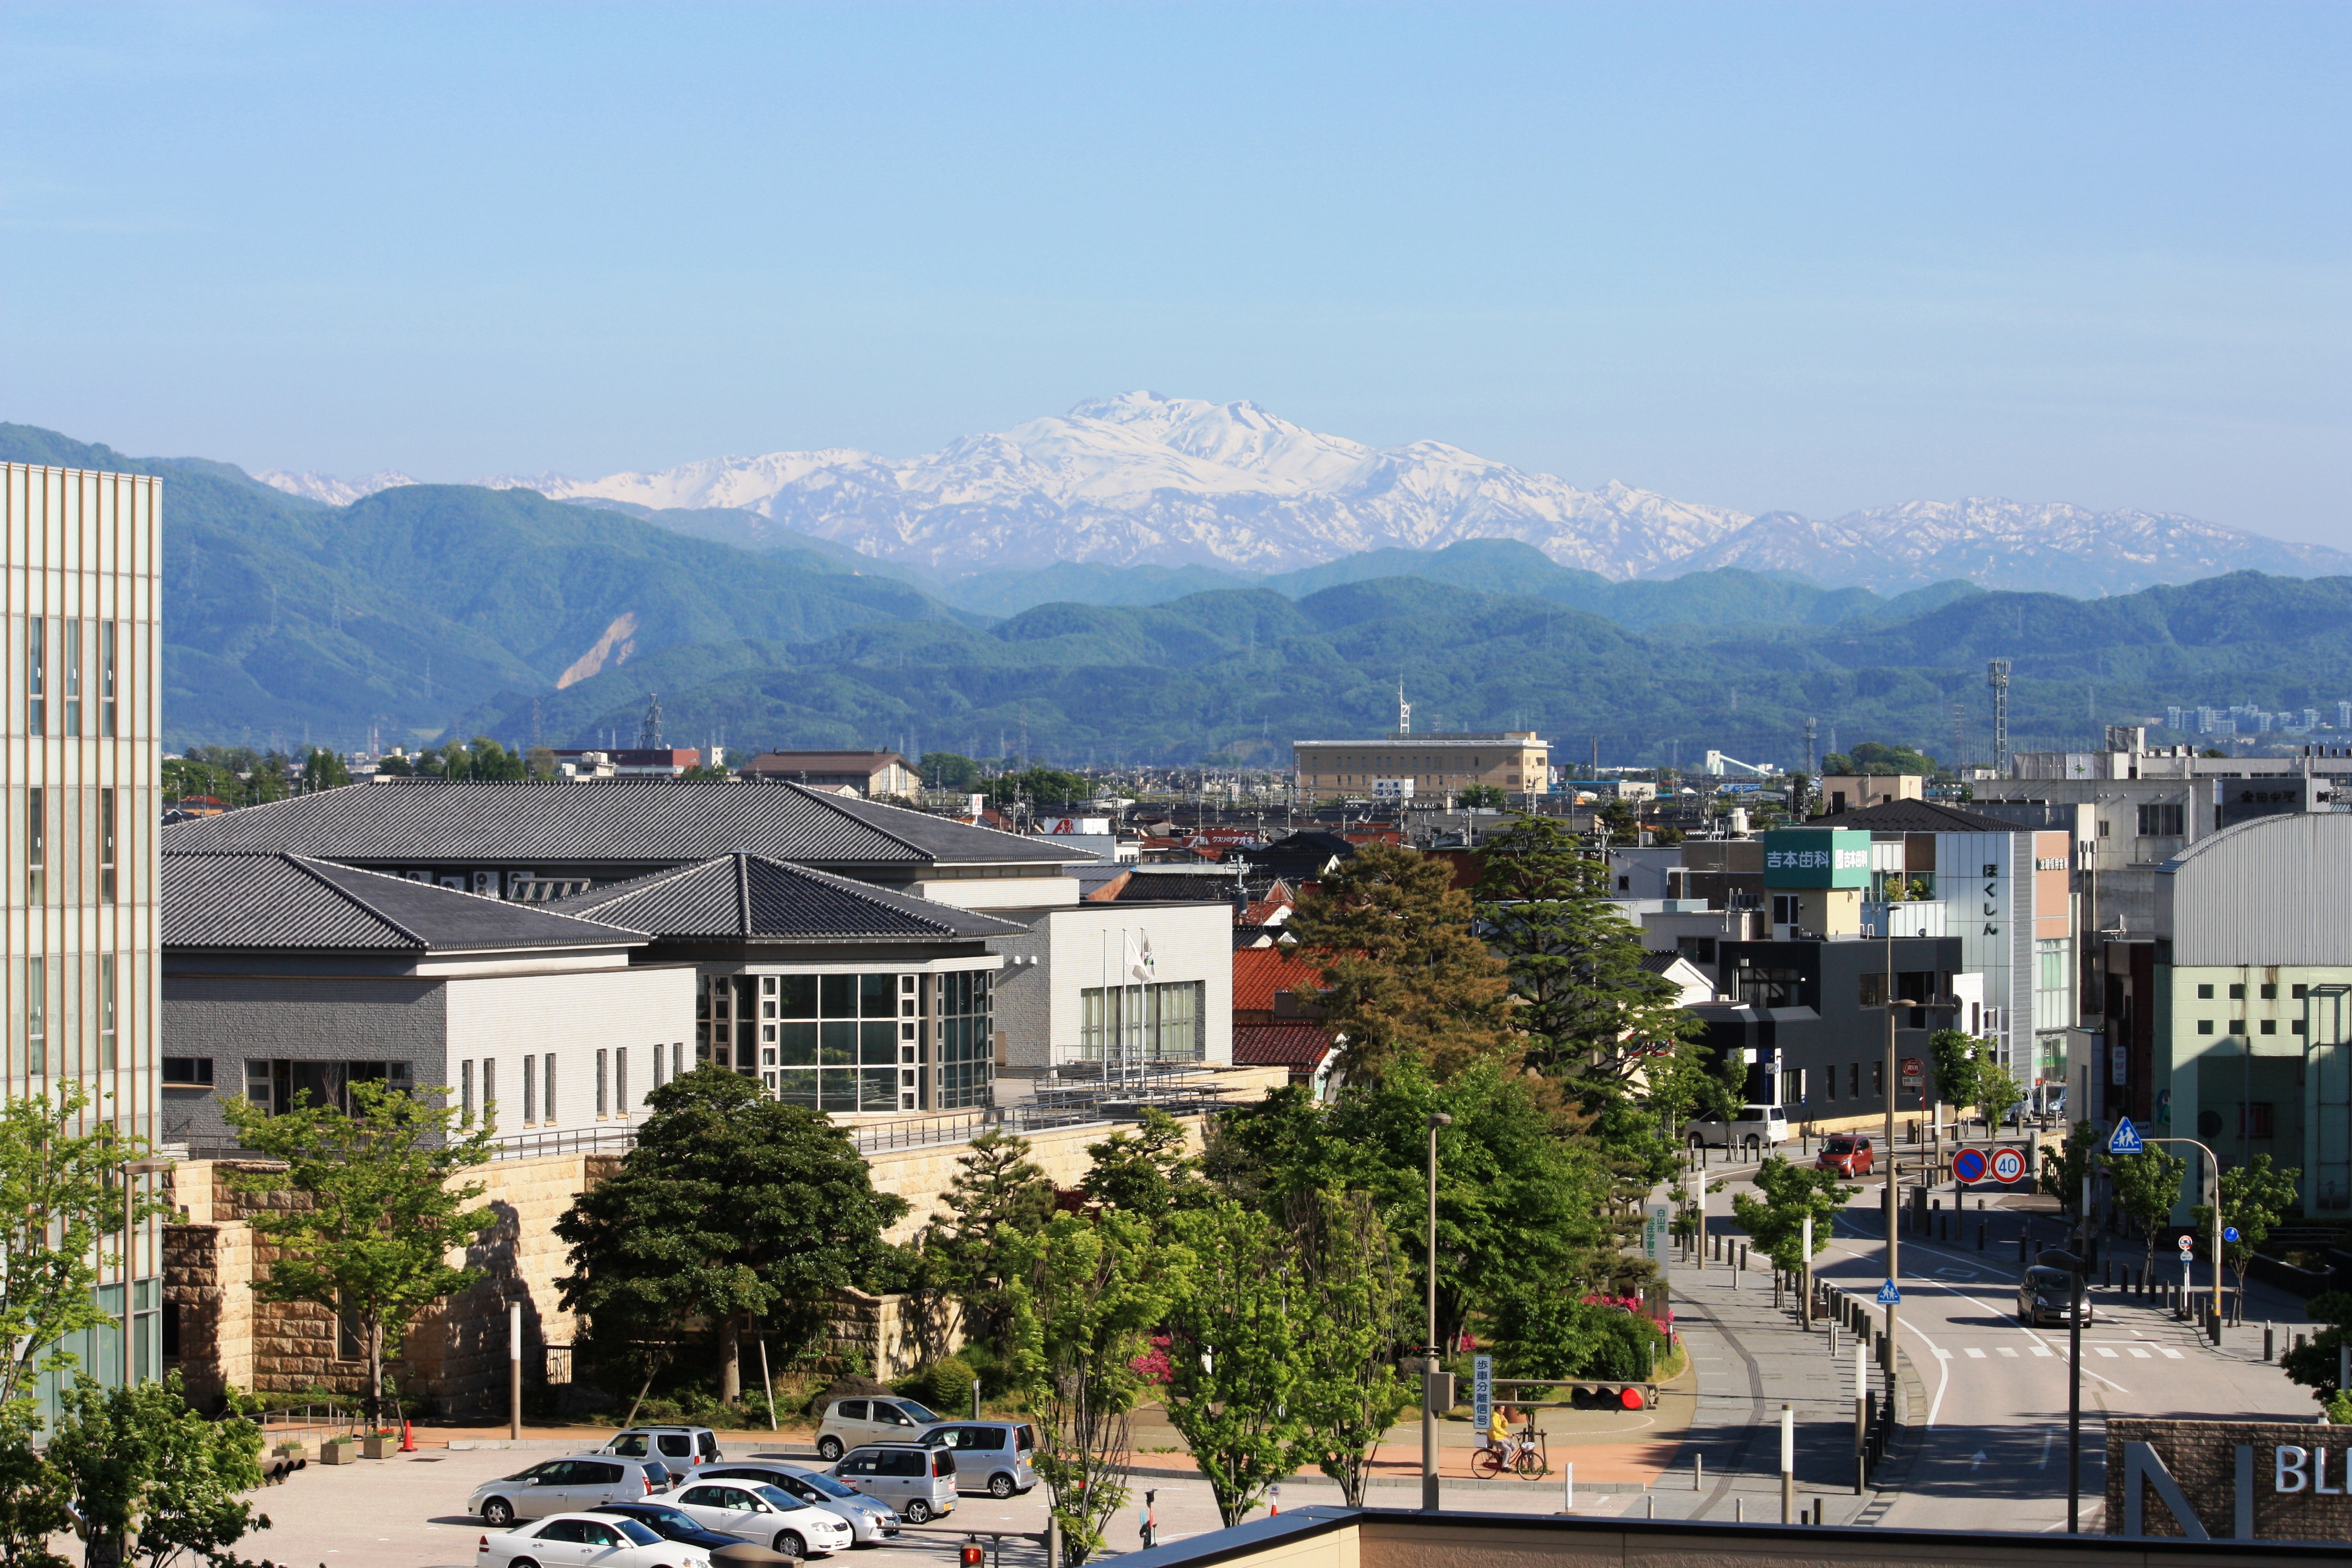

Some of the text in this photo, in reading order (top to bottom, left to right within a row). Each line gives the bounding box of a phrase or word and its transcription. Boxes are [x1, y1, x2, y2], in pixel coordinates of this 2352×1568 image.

[1212, 836, 1255, 844] クスリのアオキ
[1767, 851, 1830, 868] 吉本歯科
[1844, 850, 1868, 868] 吉本歯科
[1983, 864, 1998, 935] ほくしん
[1999, 1158, 2017, 1173] 40
[1657, 1208, 1665, 1233] 白山市
[1647, 1217, 1655, 1261] 松任学習セ
[1477, 1360, 1488, 1425] 歩車分離信号
[2275, 1445, 2352, 1494] BL
